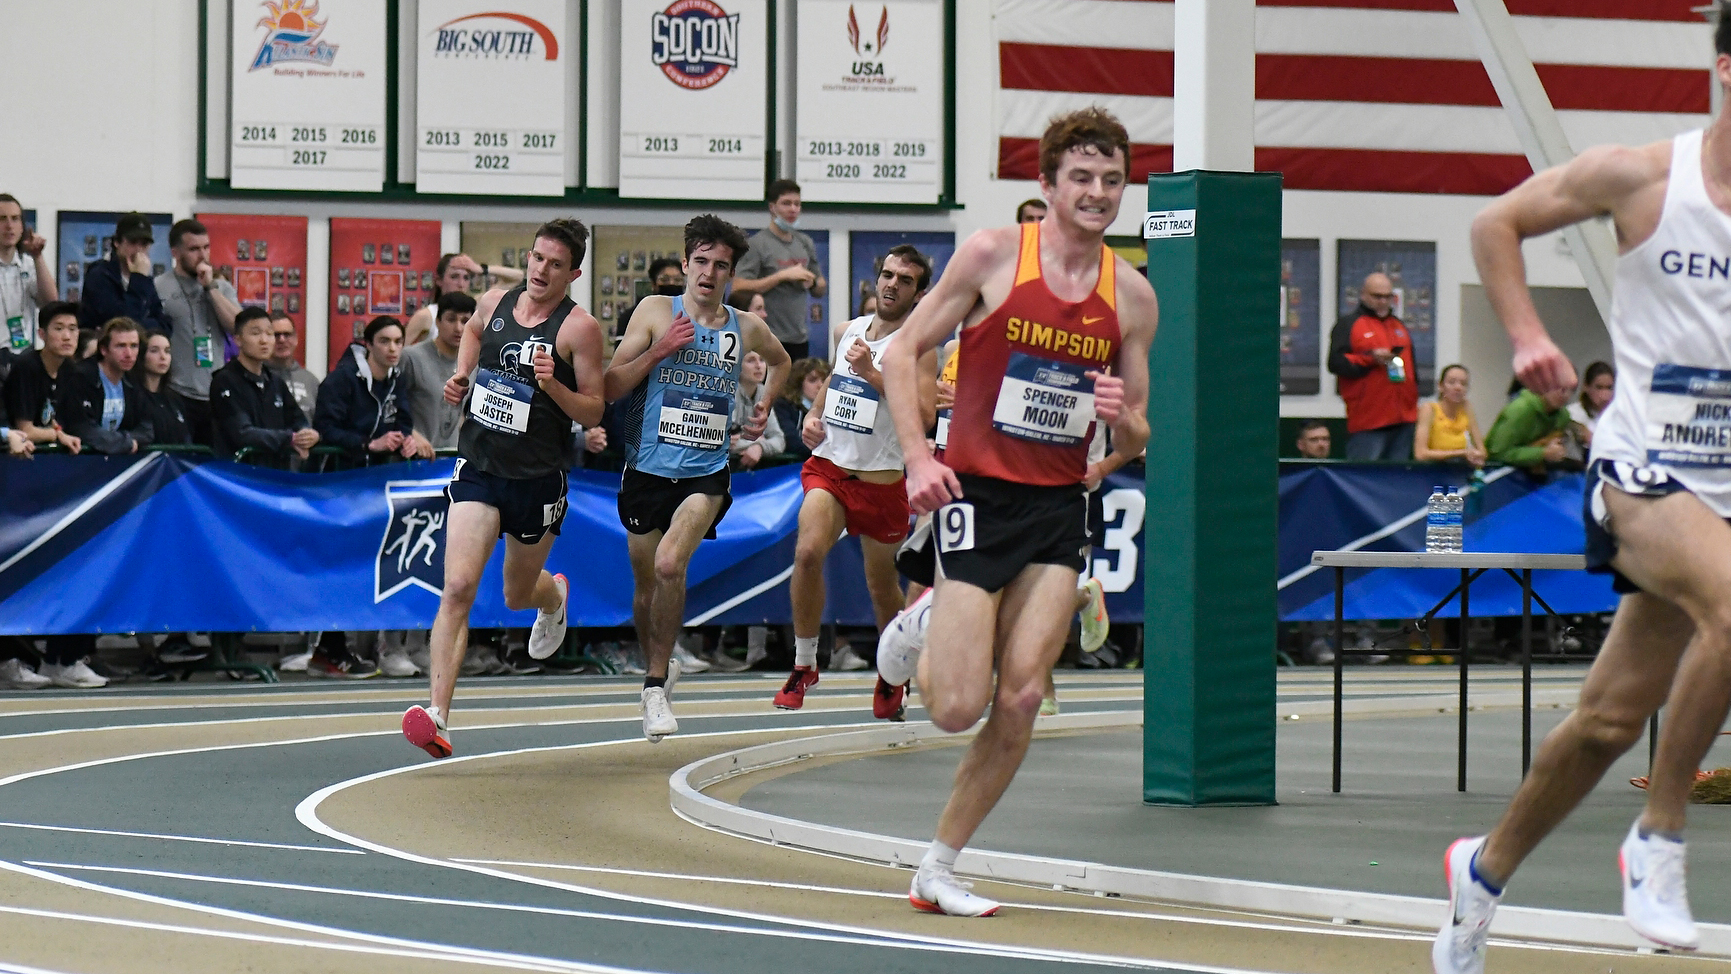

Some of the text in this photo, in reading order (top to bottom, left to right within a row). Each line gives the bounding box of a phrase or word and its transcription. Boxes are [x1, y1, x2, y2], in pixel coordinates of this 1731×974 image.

[436, 30, 534, 54] BIG SOUTH
[852, 62, 884, 75] USA
[242, 127, 377, 144] 2014 2015 2016
[426, 131, 556, 148] 2013 2015 2017
[645, 138, 742, 152] 2013 2014
[293, 151, 327, 165] 2017
[809, 141, 926, 157] 2013-2018 2019
[475, 155, 510, 170] 2022
[827, 164, 906, 179] 2020 2022
[1149, 219, 1193, 231] FAST TRACK
[1660, 250, 1730, 279] GEN
[723, 332, 736, 362] 2
[1006, 316, 1112, 362] SIMPSON
[674, 349, 734, 374] JOHNS
[658, 367, 736, 395] HOPKINS
[483, 393, 513, 411] JOSEPH
[839, 395, 857, 408] RYAN
[1023, 387, 1078, 410] SPENCER
[479, 403, 514, 425] JASTER
[682, 413, 709, 425] GAVIN
[834, 405, 857, 420] CORY
[1022, 406, 1069, 430] MOON
[1695, 403, 1731, 421] NICK
[659, 421, 724, 441] MCELHENNON
[1662, 423, 1731, 447] ANDRE
[550, 499, 562, 522] 18
[946, 506, 966, 548] 9
[1078, 489, 1146, 592] 3
